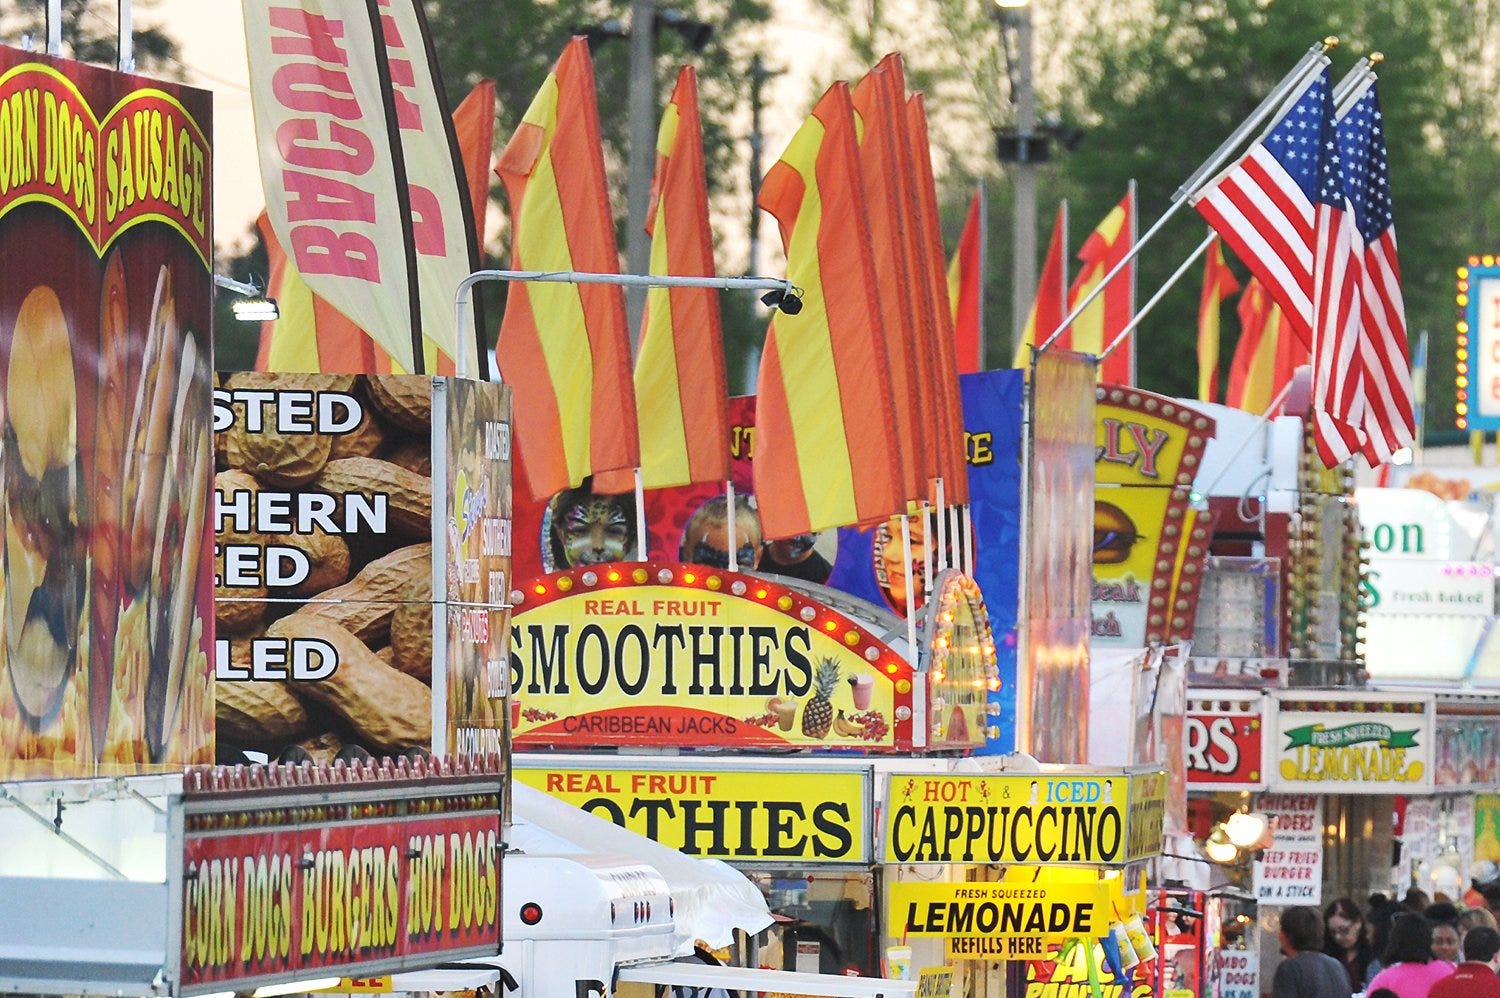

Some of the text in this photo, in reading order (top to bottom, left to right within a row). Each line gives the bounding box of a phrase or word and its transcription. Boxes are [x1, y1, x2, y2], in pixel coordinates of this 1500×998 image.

[0, 88, 95, 226] ORN DOGS
[105, 107, 205, 234] SAUSAGE
[214, 389, 363, 435] STED
[215, 492, 389, 535] HERN
[214, 545, 310, 588] ED
[584, 599, 722, 617] REAL FRUIT
[215, 638, 340, 681] LED
[563, 715, 737, 735] CARIBBEAN JACKS
[1186, 715, 1239, 776] RS
[546, 773, 717, 795] REAL FRUIT
[1296, 744, 1407, 782] LEMONADE
[923, 780, 1101, 802] HOT & ICED
[891, 805, 1122, 863] CAPPUCCINO
[408, 828, 497, 935] HOT DOGS
[954, 889, 1047, 899] FRESH SQUEEZED
[1263, 866, 1313, 879] BURGER
[185, 852, 292, 968] CORN DOGS
[300, 844, 399, 956] BURGERS
[907, 902, 1094, 934] LEMONADE
[951, 936, 1043, 955] REFILLS HERE
